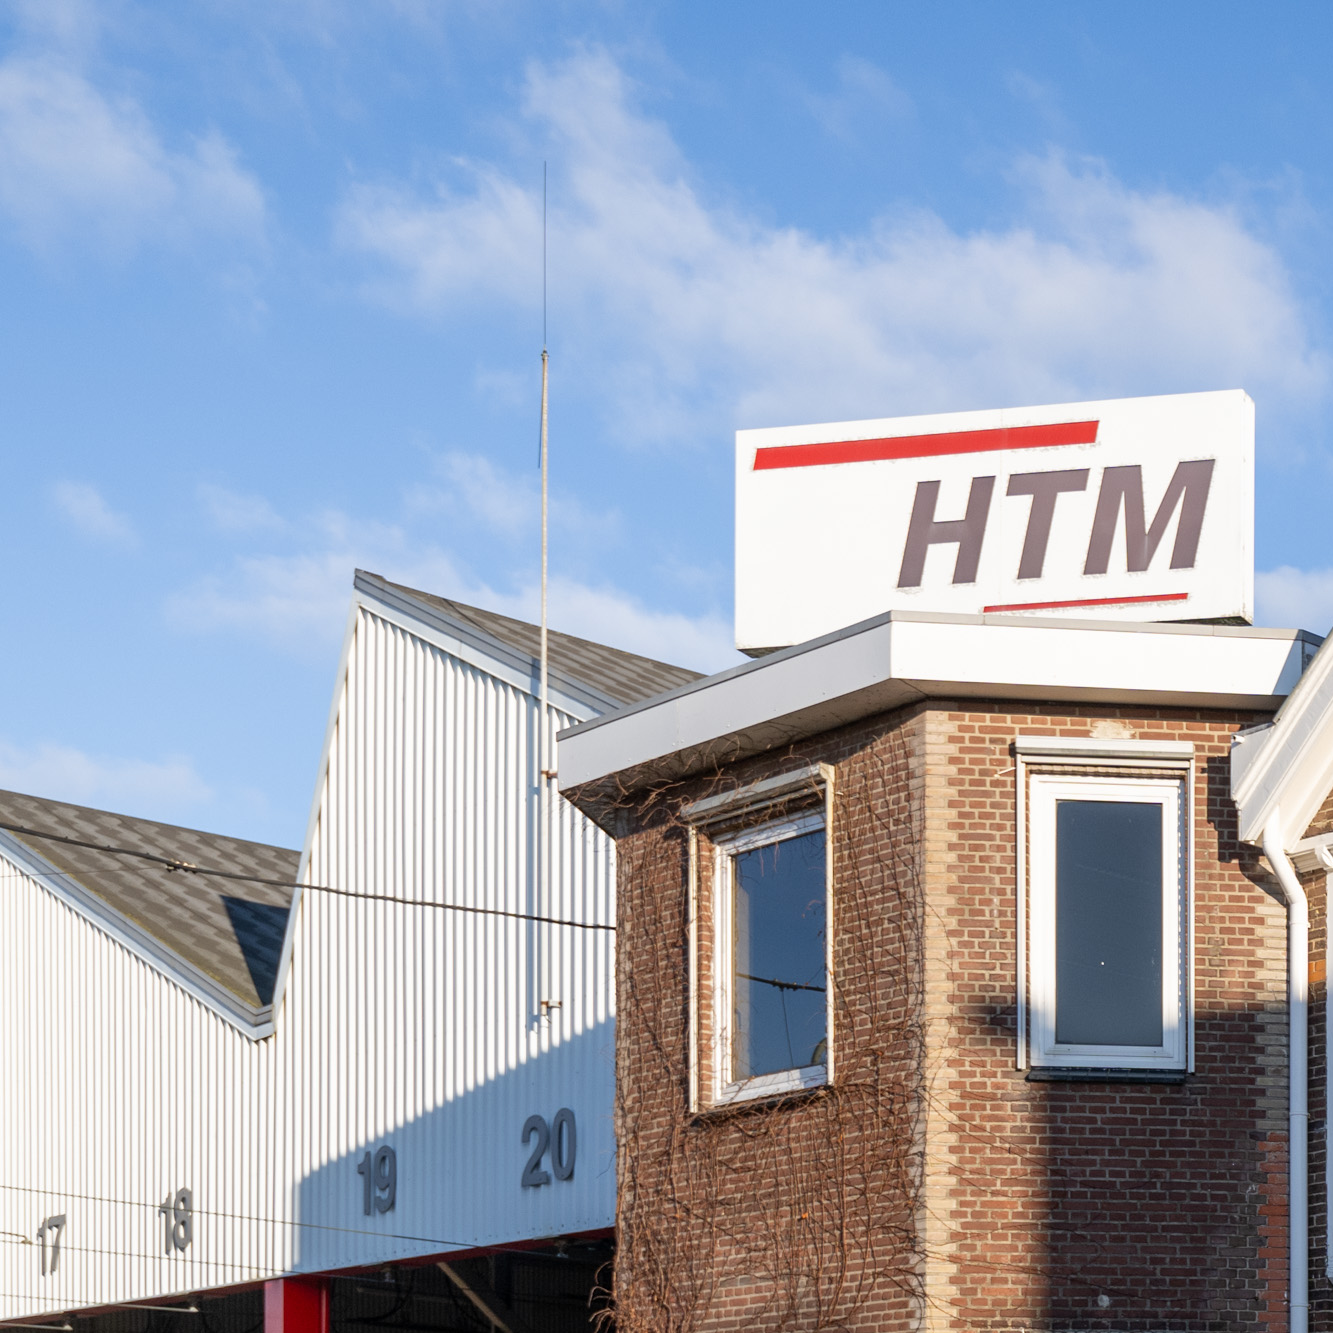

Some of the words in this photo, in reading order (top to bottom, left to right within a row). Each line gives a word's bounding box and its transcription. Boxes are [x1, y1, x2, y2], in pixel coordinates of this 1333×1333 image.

[897, 459, 1215, 588] HTM
[357, 1145, 397, 1216] 19
[521, 1107, 577, 1187] 20
[37, 1214, 66, 1277] 17
[158, 1187, 192, 1256] 18
